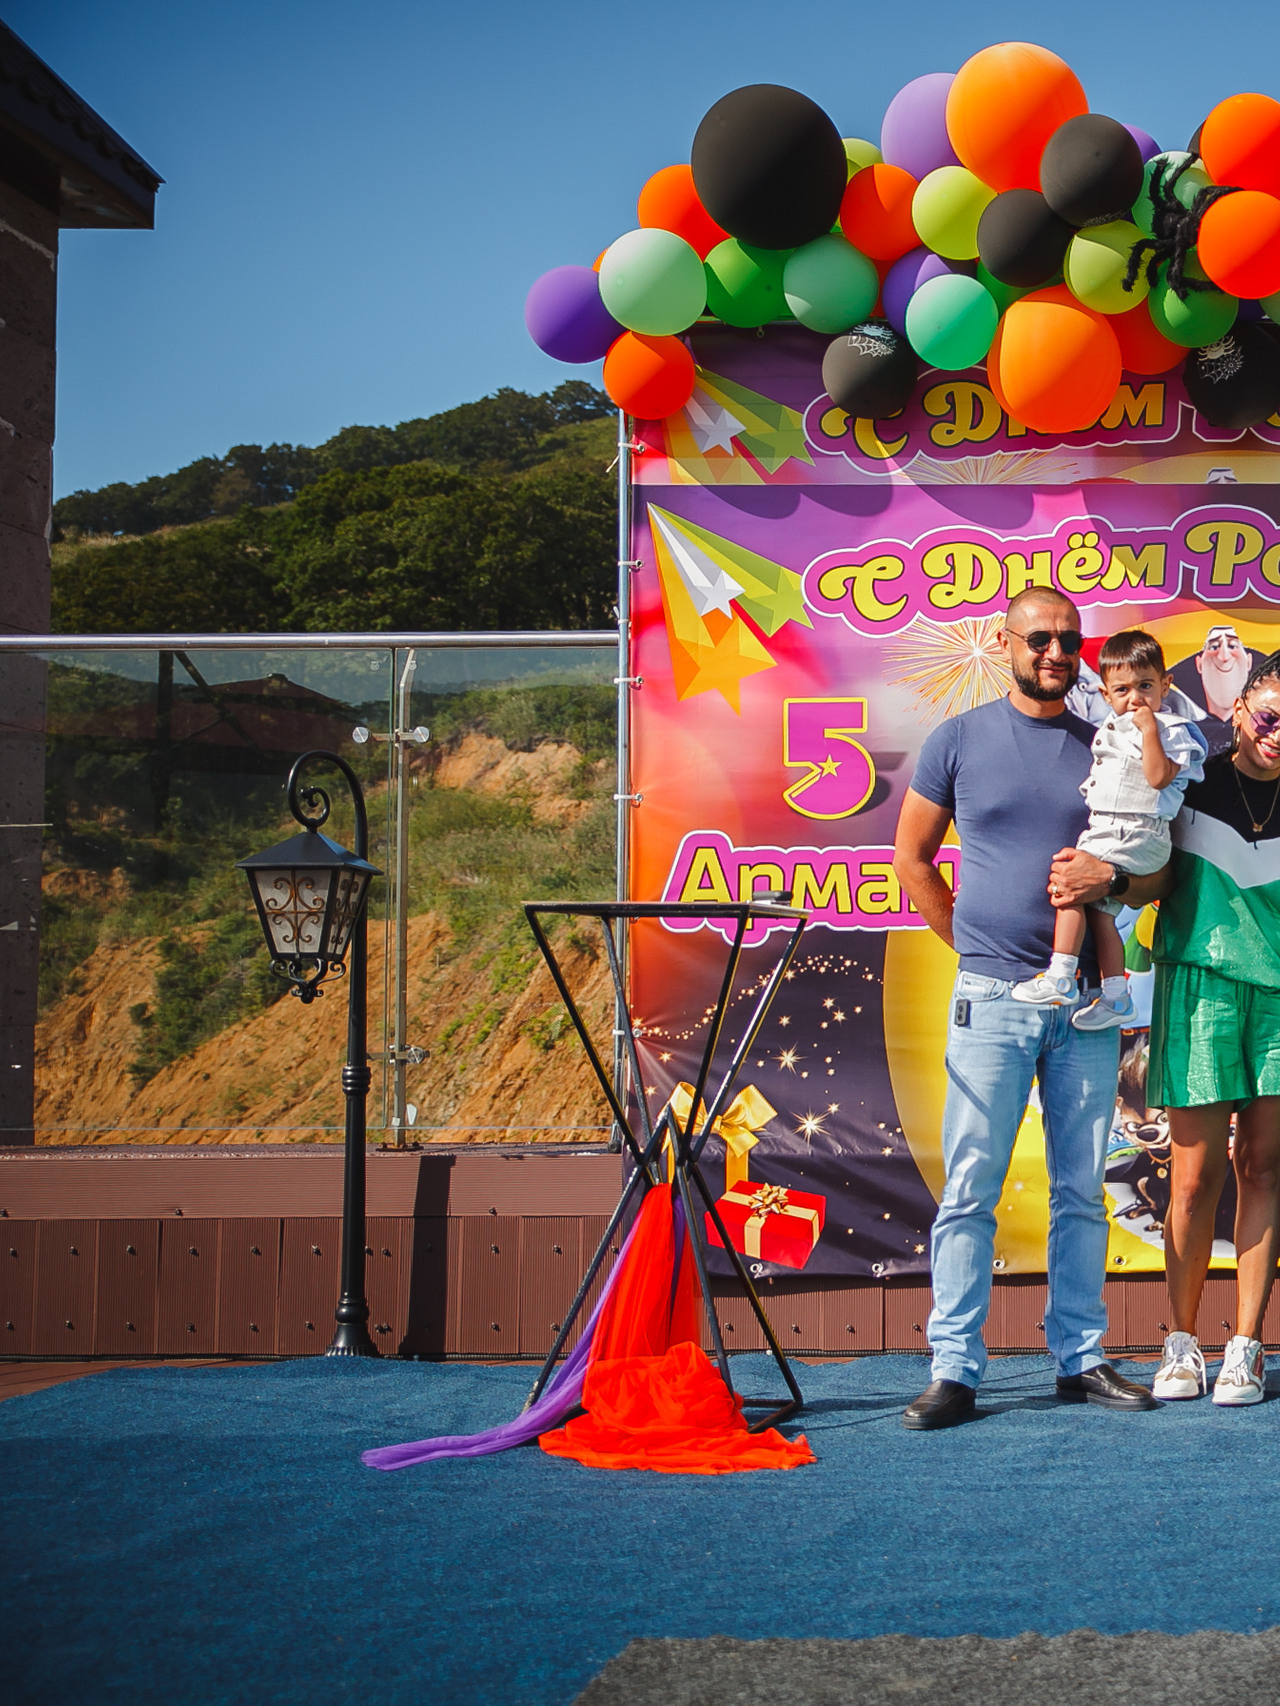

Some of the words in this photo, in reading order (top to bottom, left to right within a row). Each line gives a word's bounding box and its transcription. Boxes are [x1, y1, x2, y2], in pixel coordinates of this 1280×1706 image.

[922, 380, 1166, 447] Дм
[819, 552, 909, 624] С
[920, 532, 1167, 612] Днём
[783, 697, 876, 820] 5
[677, 846, 956, 931] Арма
